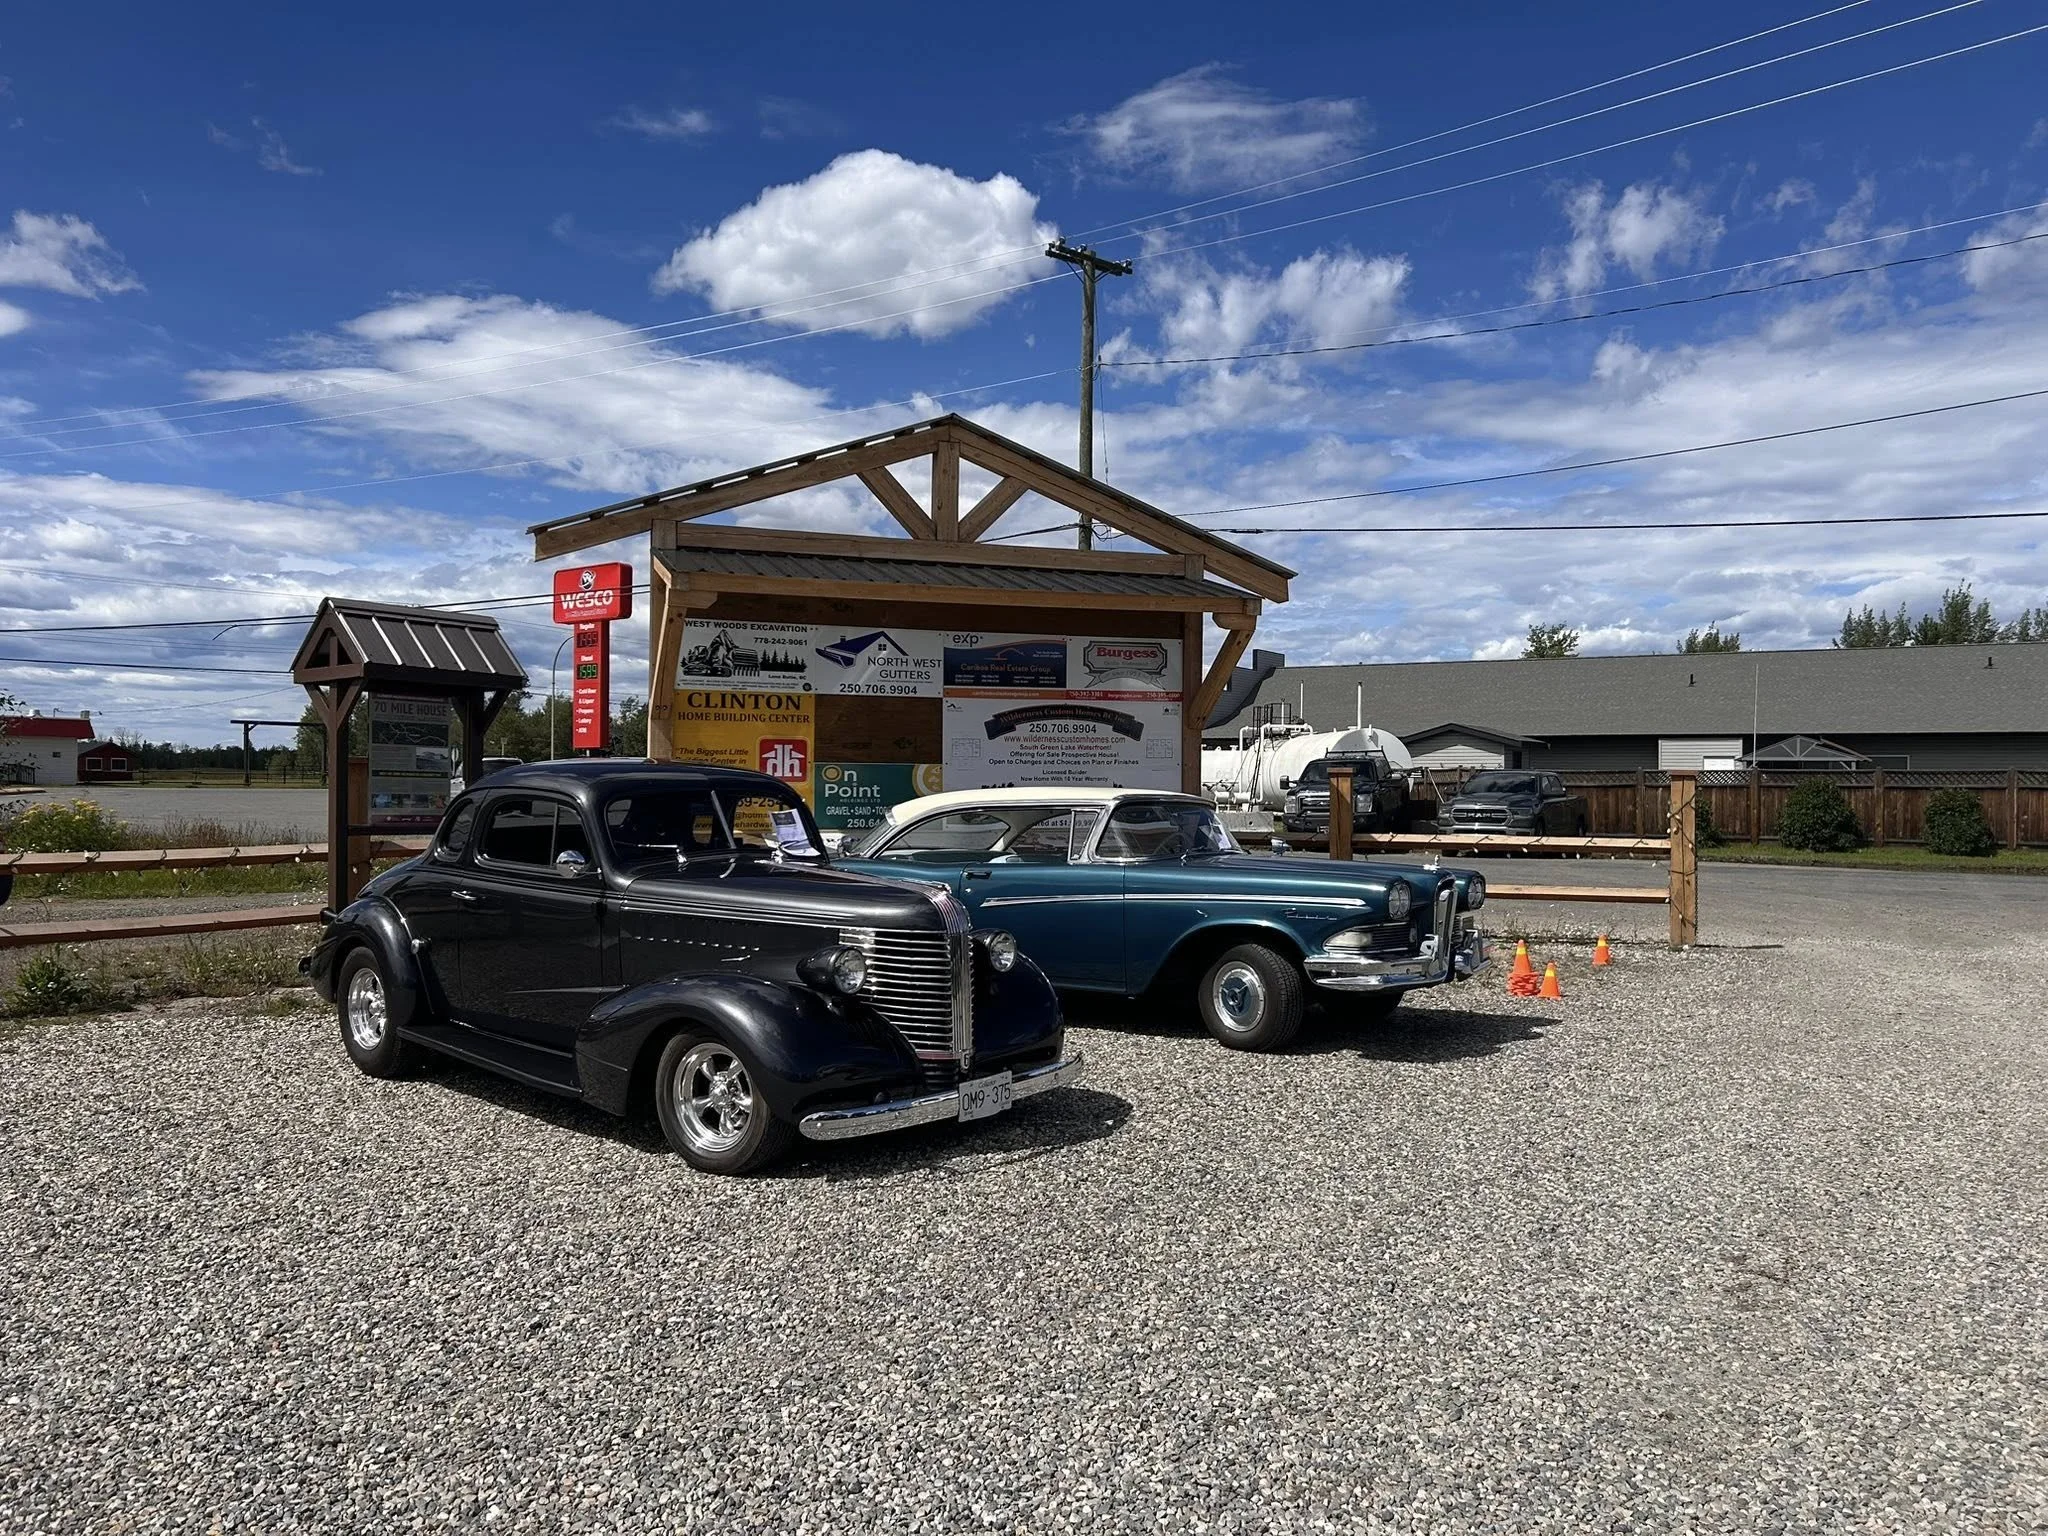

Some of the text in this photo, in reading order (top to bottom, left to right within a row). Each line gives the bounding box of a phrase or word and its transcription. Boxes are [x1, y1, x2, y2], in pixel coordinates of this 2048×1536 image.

[684, 619, 808, 633] WEST WOODS EXCAVATION
[753, 636, 808, 646] 778-242-9061
[1096, 646, 1159, 661] Burgess
[867, 656, 942, 668] NORTH WEST
[879, 669, 931, 680] GUTTERS
[990, 664, 1006, 672] Real
[1007, 664, 1029, 673] Estate
[1030, 665, 1051, 675] Group
[839, 683, 918, 695] 250.706.9904
[687, 692, 801, 711] CLINTON
[374, 701, 447, 716] 70 MILE HOUSE
[678, 711, 810, 724] HOME BUILDING CENTER
[1028, 723, 1098, 734] 250.706.9904
[1003, 734, 1127, 745] www.wildernesscustomhomes.com
[696, 747, 727, 757] Biggest
[728, 748, 749, 756] Little
[1019, 743, 1039, 751] South
[738, 757, 747, 765] in
[1009, 751, 1035, 759] Offering
[1061, 752, 1097, 760] Prospective
[1014, 759, 1042, 767] Changes
[822, 764, 858, 782] On
[824, 782, 881, 798] Point
[825, 806, 851, 816] GRAVEL
[854, 807, 872, 816] SAND
